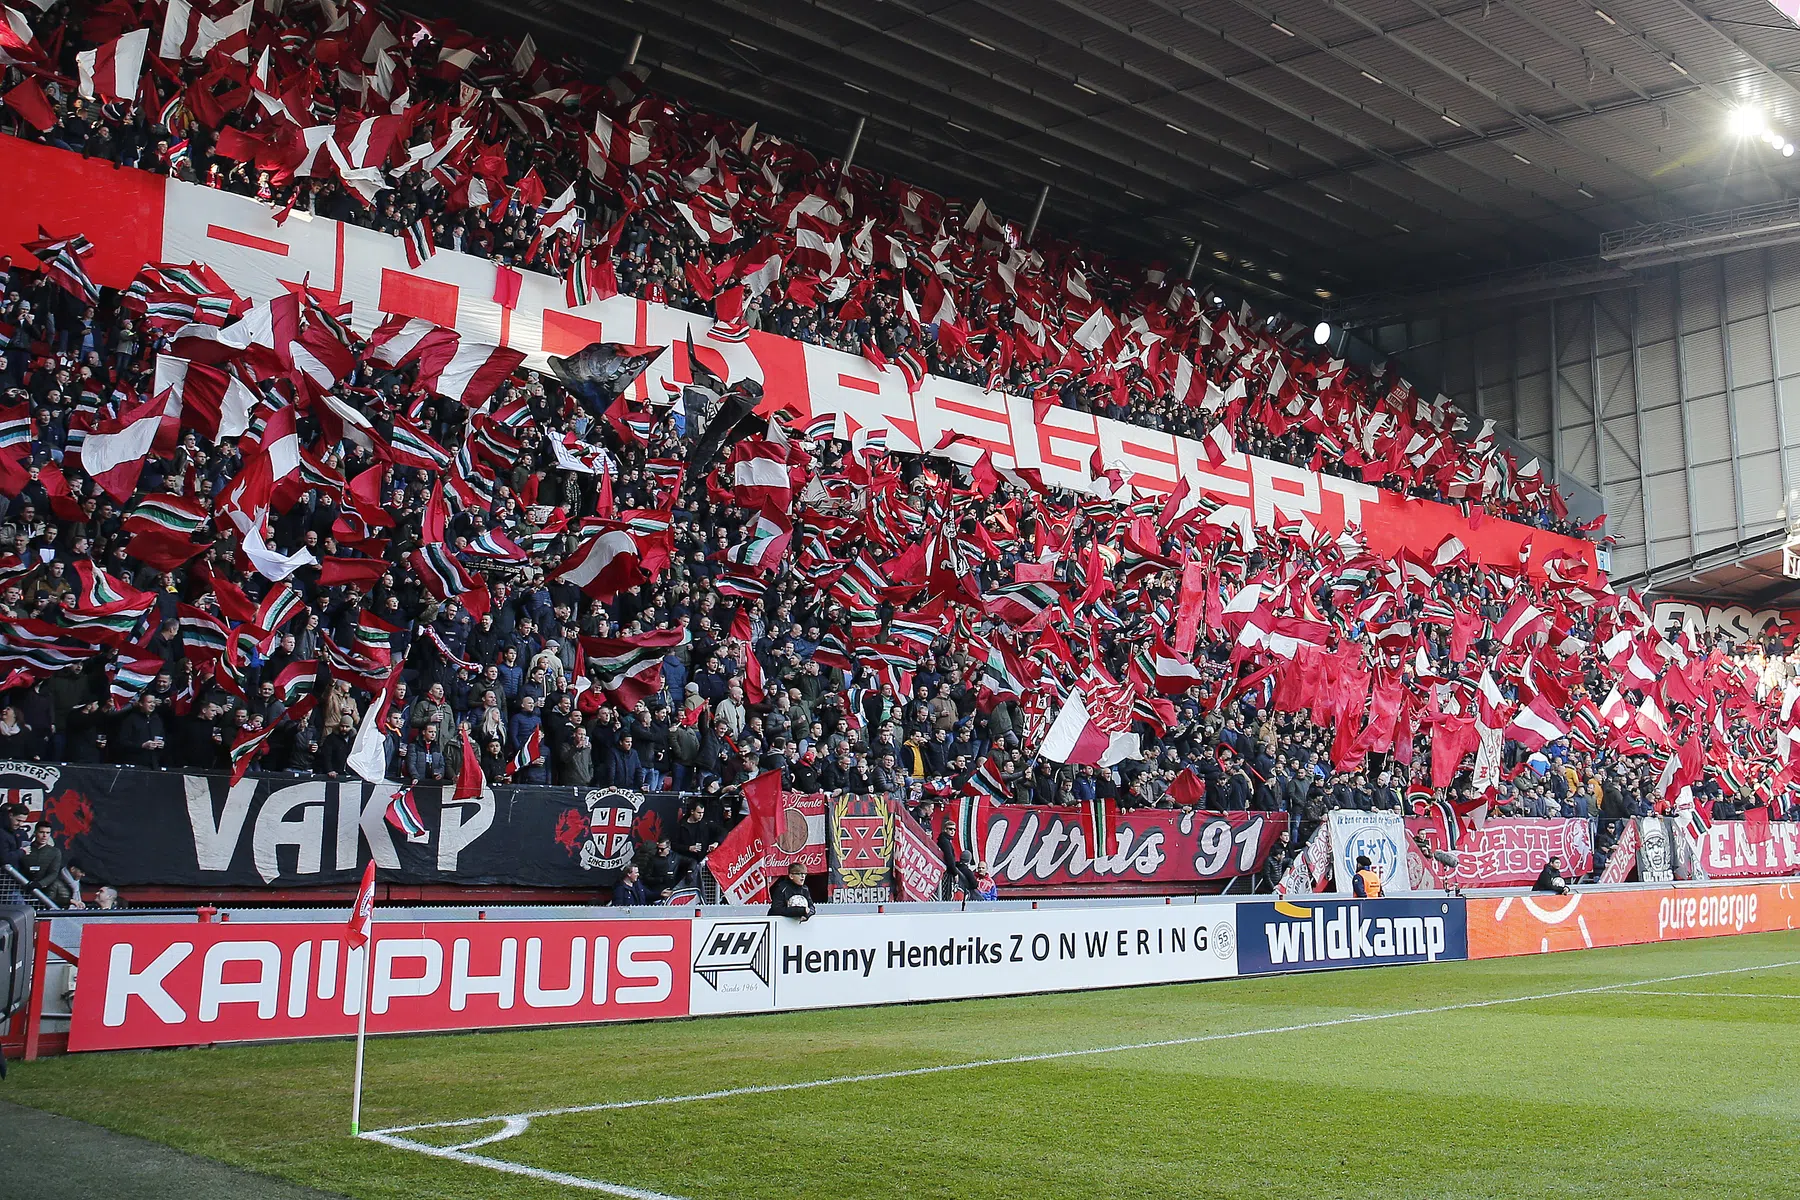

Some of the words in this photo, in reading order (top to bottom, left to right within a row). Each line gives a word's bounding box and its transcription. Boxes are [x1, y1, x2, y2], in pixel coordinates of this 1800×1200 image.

[592, 787, 638, 804] SUPPRTERS
[587, 857, 606, 868] SINCE
[765, 854, 790, 867] Sinds
[792, 853, 823, 866] 1965
[1643, 869, 1674, 882] ULTRAS
[1658, 896, 1697, 939] pure
[1699, 893, 1758, 932] energie
[1218, 931, 1229, 944] 55
[1265, 905, 1445, 964] wildkamp
[708, 931, 757, 956] HH
[783, 945, 876, 977] Henny
[887, 936, 1002, 969] Hendriks
[1009, 925, 1208, 962] ZONWERING
[102, 934, 673, 1027] KAMPHUIS
[721, 983, 740, 993] Sinds
